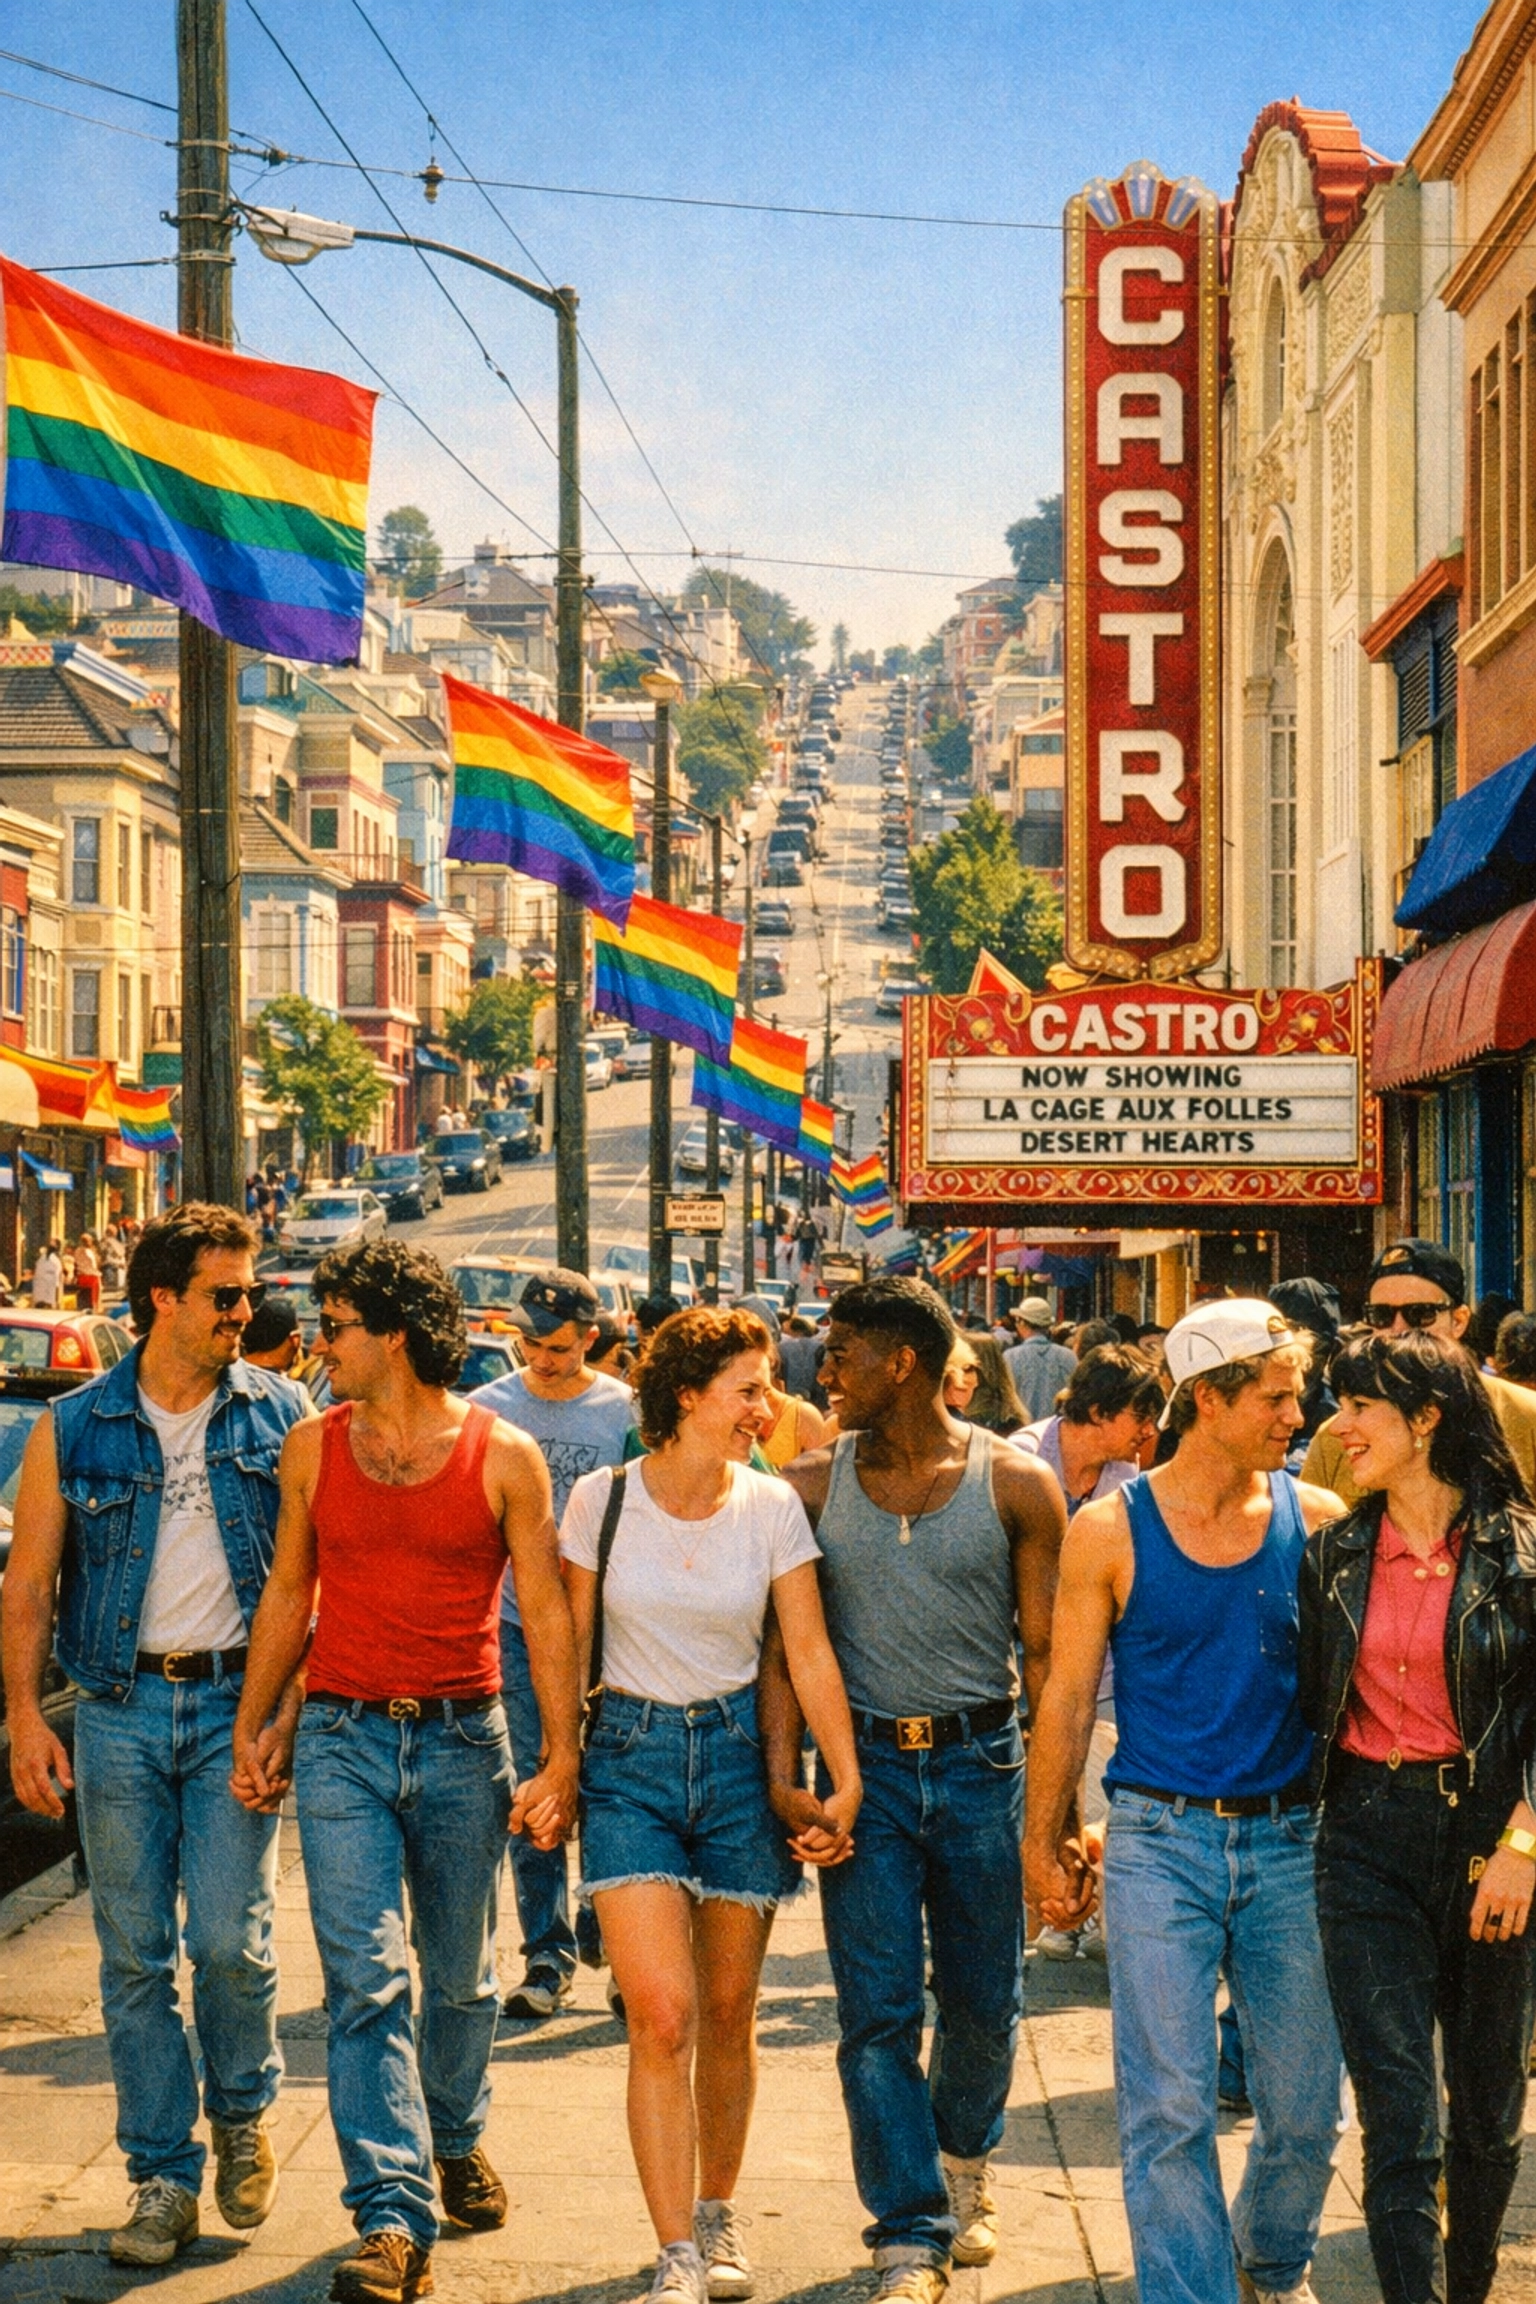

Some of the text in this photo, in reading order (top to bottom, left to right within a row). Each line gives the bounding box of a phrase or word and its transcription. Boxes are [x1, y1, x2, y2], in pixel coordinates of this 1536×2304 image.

[1097, 246, 1186, 938] CASTRO
[1029, 1003, 1259, 1051] CASTRO
[1021, 1065, 1243, 1089] NOW SHOWING
[983, 1097, 1294, 1122] LA CAGE AUX FOLLES
[1020, 1129, 1256, 1155] DESERT HEARTS
